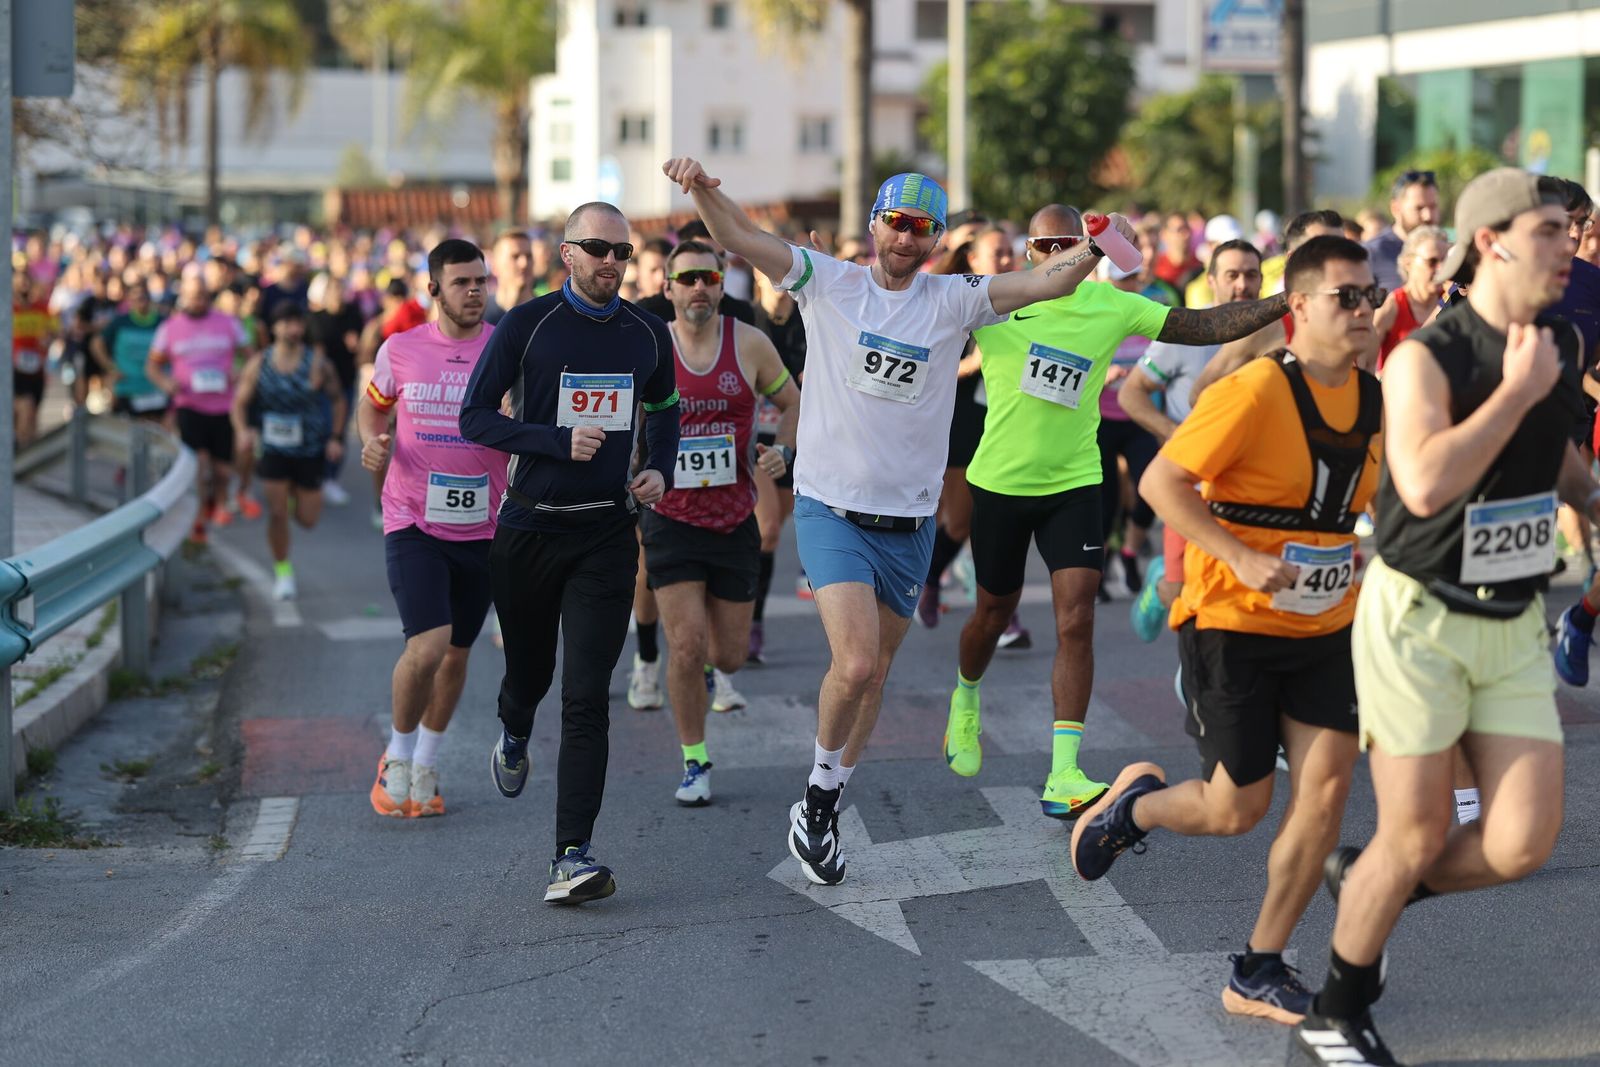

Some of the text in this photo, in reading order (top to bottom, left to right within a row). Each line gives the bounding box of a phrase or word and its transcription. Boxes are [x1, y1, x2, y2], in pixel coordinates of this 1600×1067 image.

[864, 351, 917, 384] 972
[1030, 359, 1082, 391] 1471
[403, 382, 442, 401] MEDIA
[572, 390, 618, 412] 971
[679, 396, 728, 416] Ripon
[678, 449, 730, 471] 1911
[446, 489, 476, 508] 58
[1472, 518, 1550, 556] 2208
